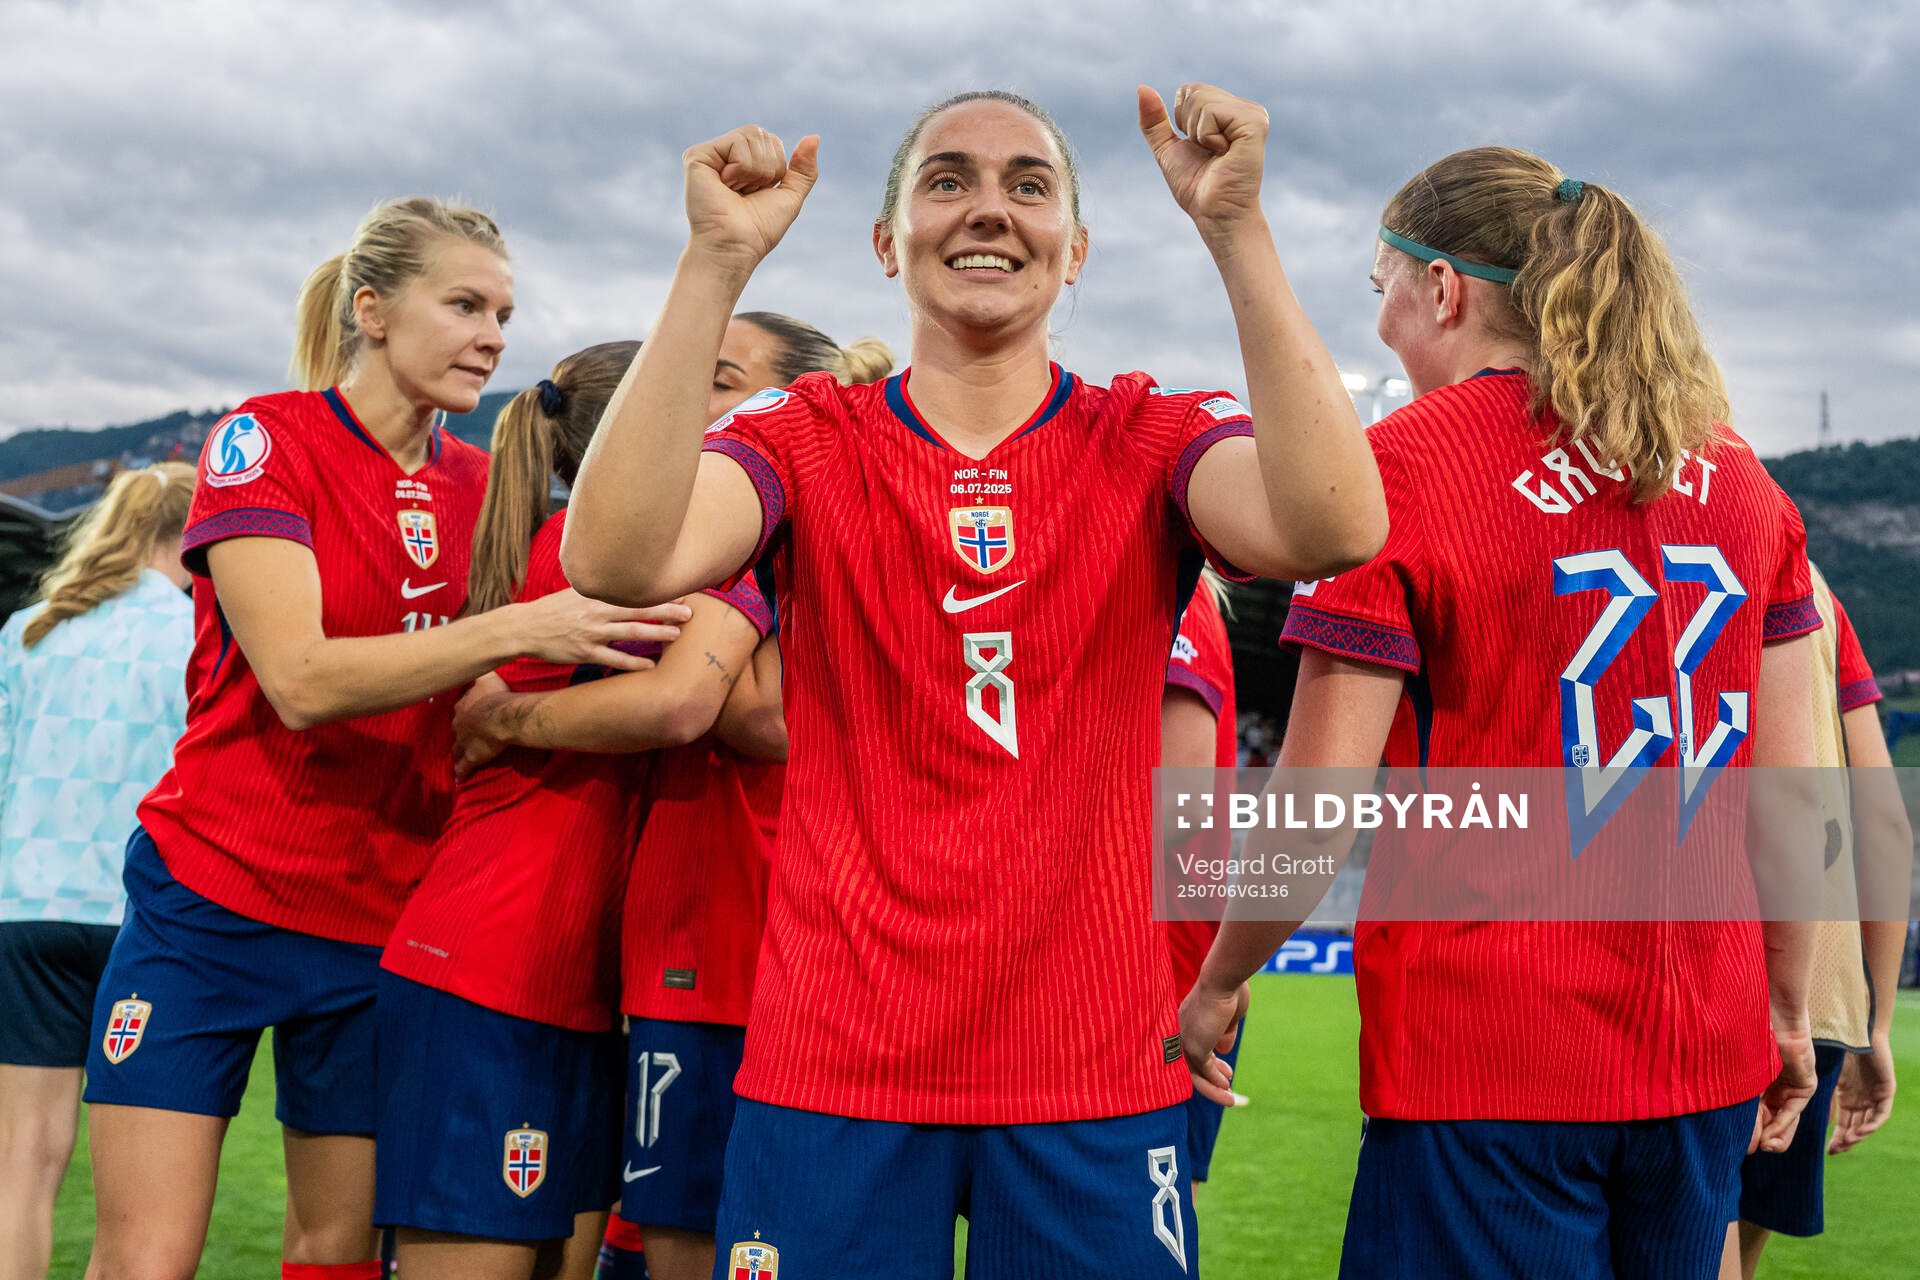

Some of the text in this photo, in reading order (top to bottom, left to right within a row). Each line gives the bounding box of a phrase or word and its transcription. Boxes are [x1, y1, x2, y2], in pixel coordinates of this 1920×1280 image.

[950, 483, 1012, 494] 06.07.2025
[954, 468, 979, 480] NOR
[989, 468, 1008, 480] FIN
[963, 632, 1019, 760] 8
[1553, 544, 1748, 861] 22
[636, 1051, 682, 1148] 17
[1148, 1146, 1187, 1275] 8
